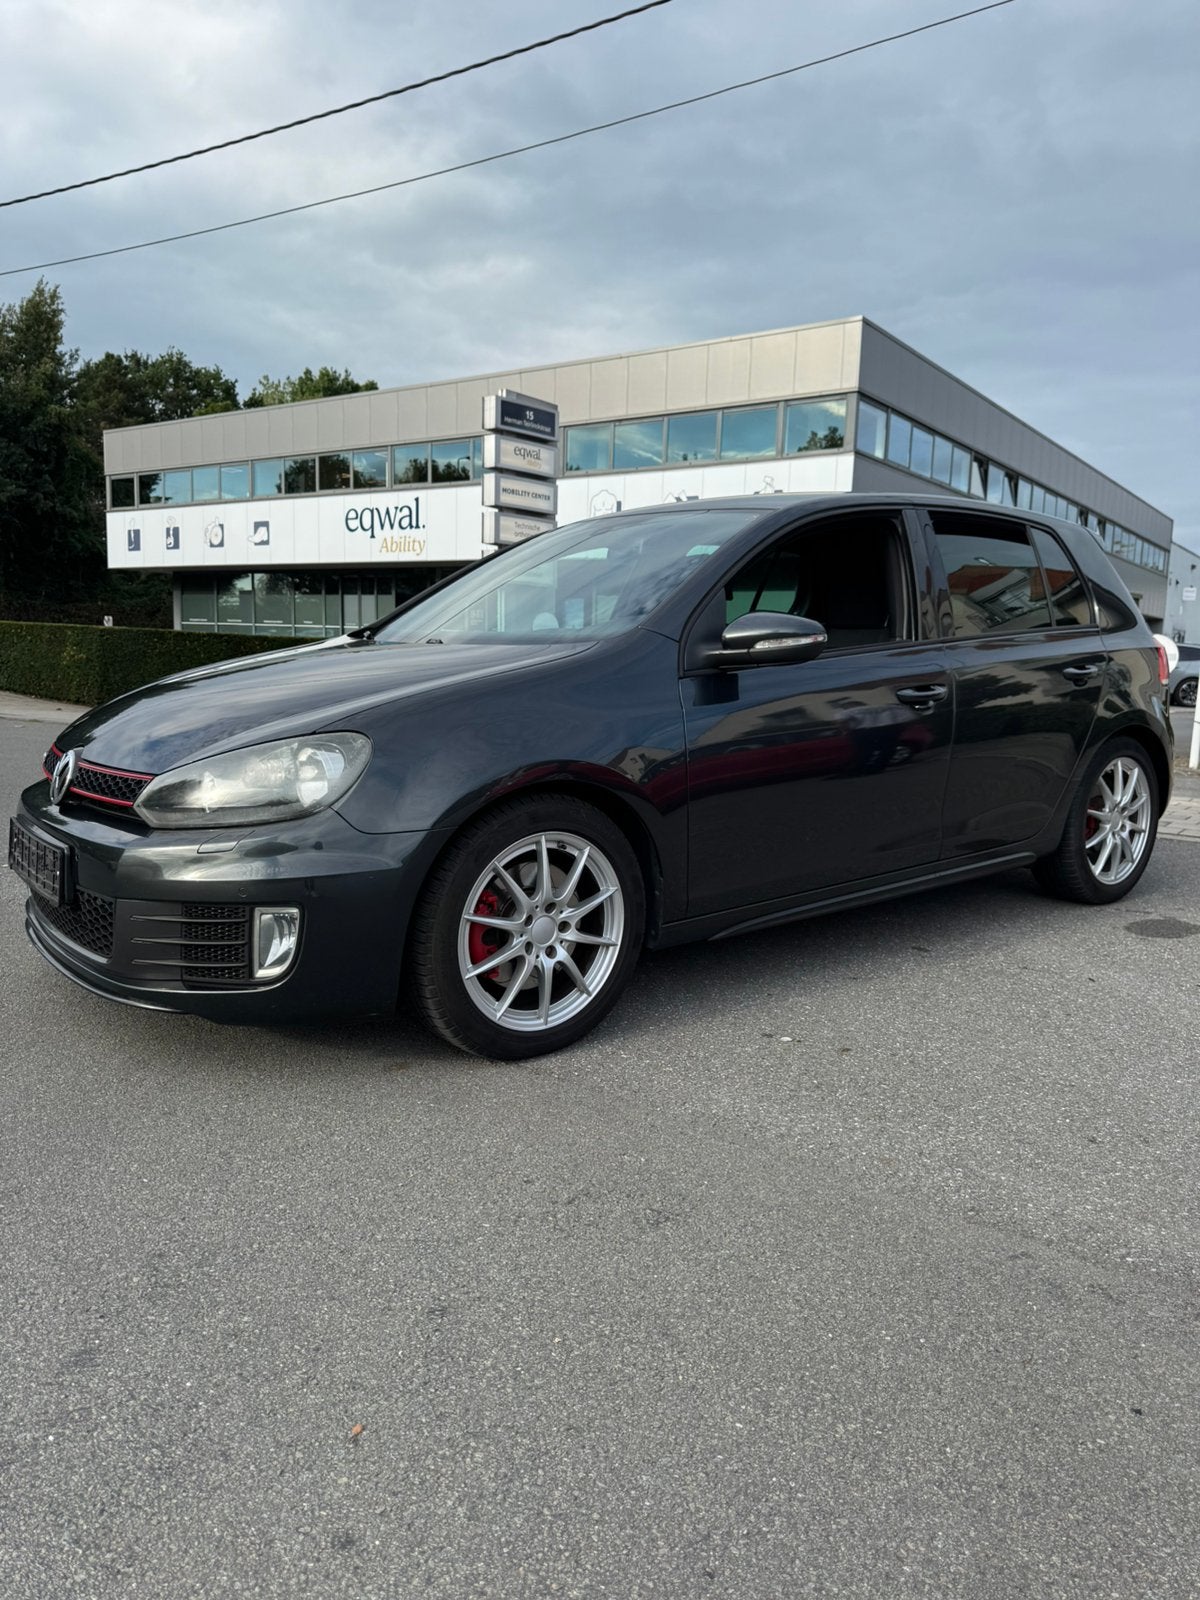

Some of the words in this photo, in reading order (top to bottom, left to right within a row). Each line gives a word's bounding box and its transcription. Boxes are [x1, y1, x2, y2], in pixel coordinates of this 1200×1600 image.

[526, 410, 534, 420] 15
[502, 487, 530, 497] MOBILITY
[531, 492, 551, 501] CENTER
[379, 535, 426, 556] Ability
